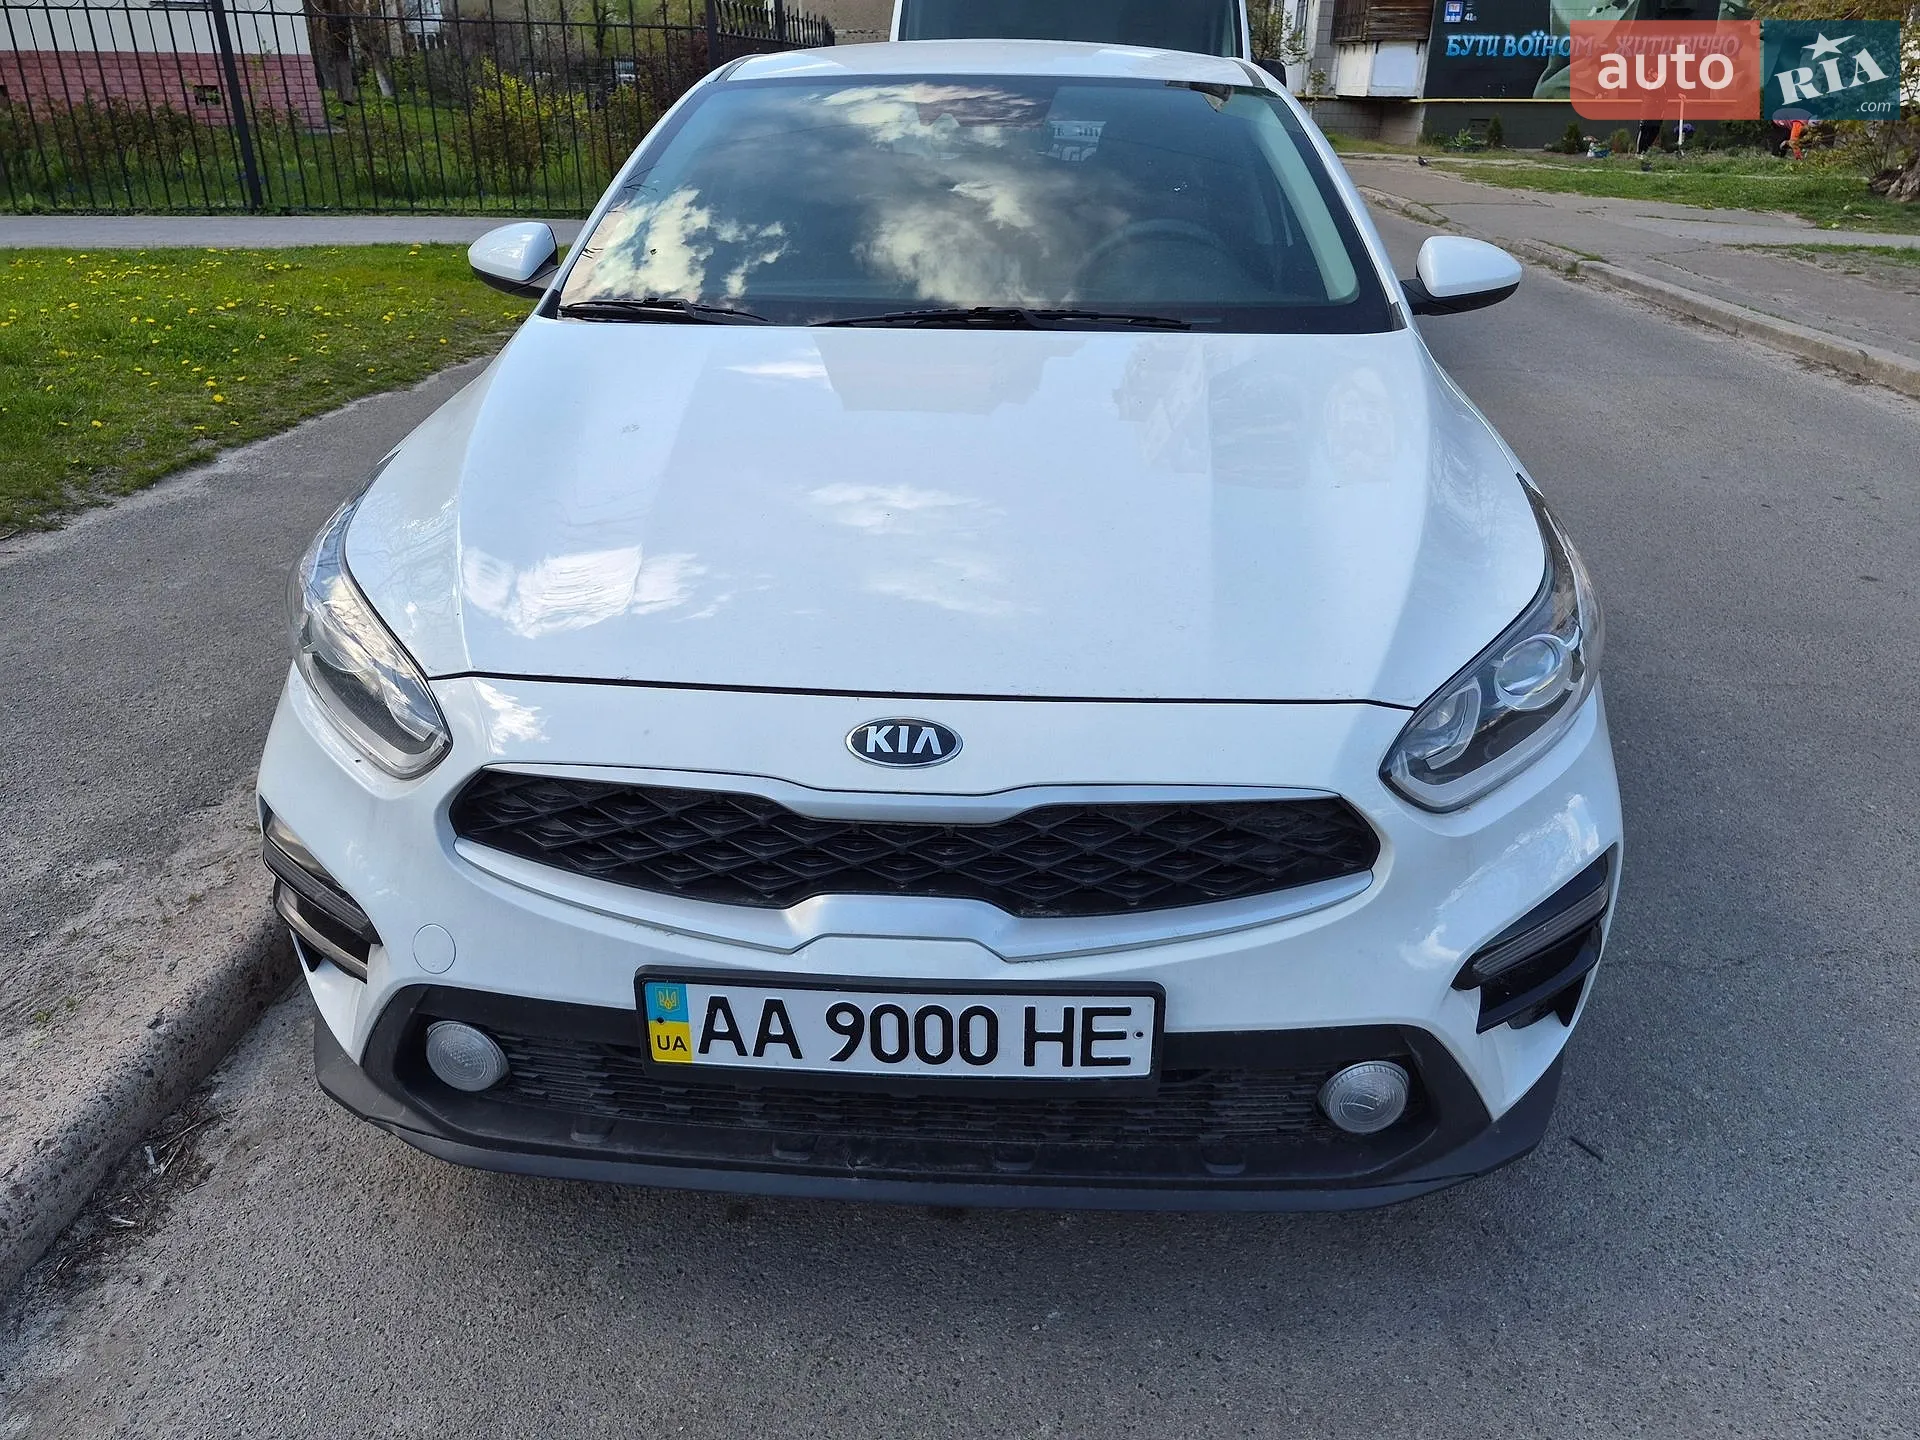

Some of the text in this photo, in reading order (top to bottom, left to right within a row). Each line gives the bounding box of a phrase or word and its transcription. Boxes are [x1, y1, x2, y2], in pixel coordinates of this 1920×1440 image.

[866, 725, 943, 755] KIA
[656, 1033, 689, 1053] UA
[697, 995, 1132, 1067] AA 9000 HE
